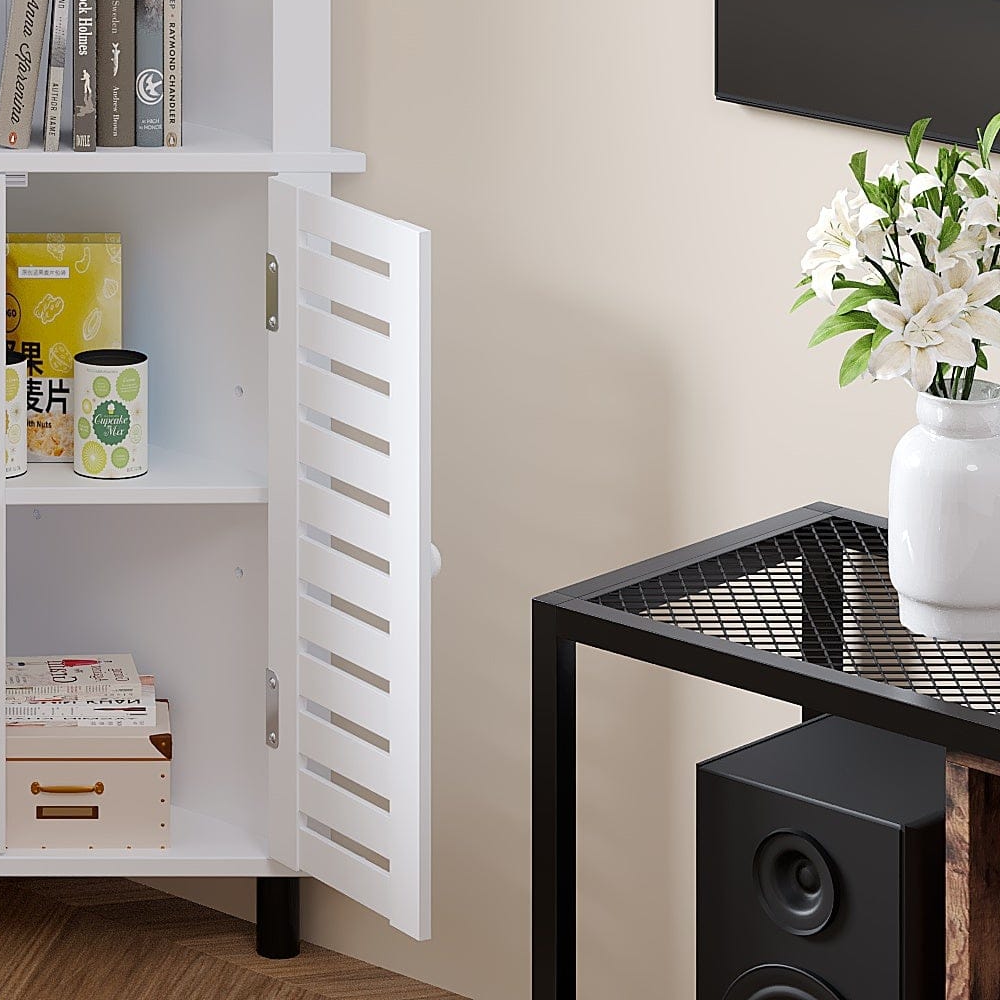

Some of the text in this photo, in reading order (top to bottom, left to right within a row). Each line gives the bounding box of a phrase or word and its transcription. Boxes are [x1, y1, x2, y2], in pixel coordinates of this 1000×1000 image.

[111, 0, 120, 34] Sweden
[78, 18, 93, 56] Holmes
[10, 42, 32, 125] Karenina
[48, 83, 59, 137] AUTHOR NAME
[6, 309, 17, 318] GO
[27, 378, 70, 414] 麦片
[36, 420, 52, 429] Nuts
[94, 413, 129, 427] Cupcake
